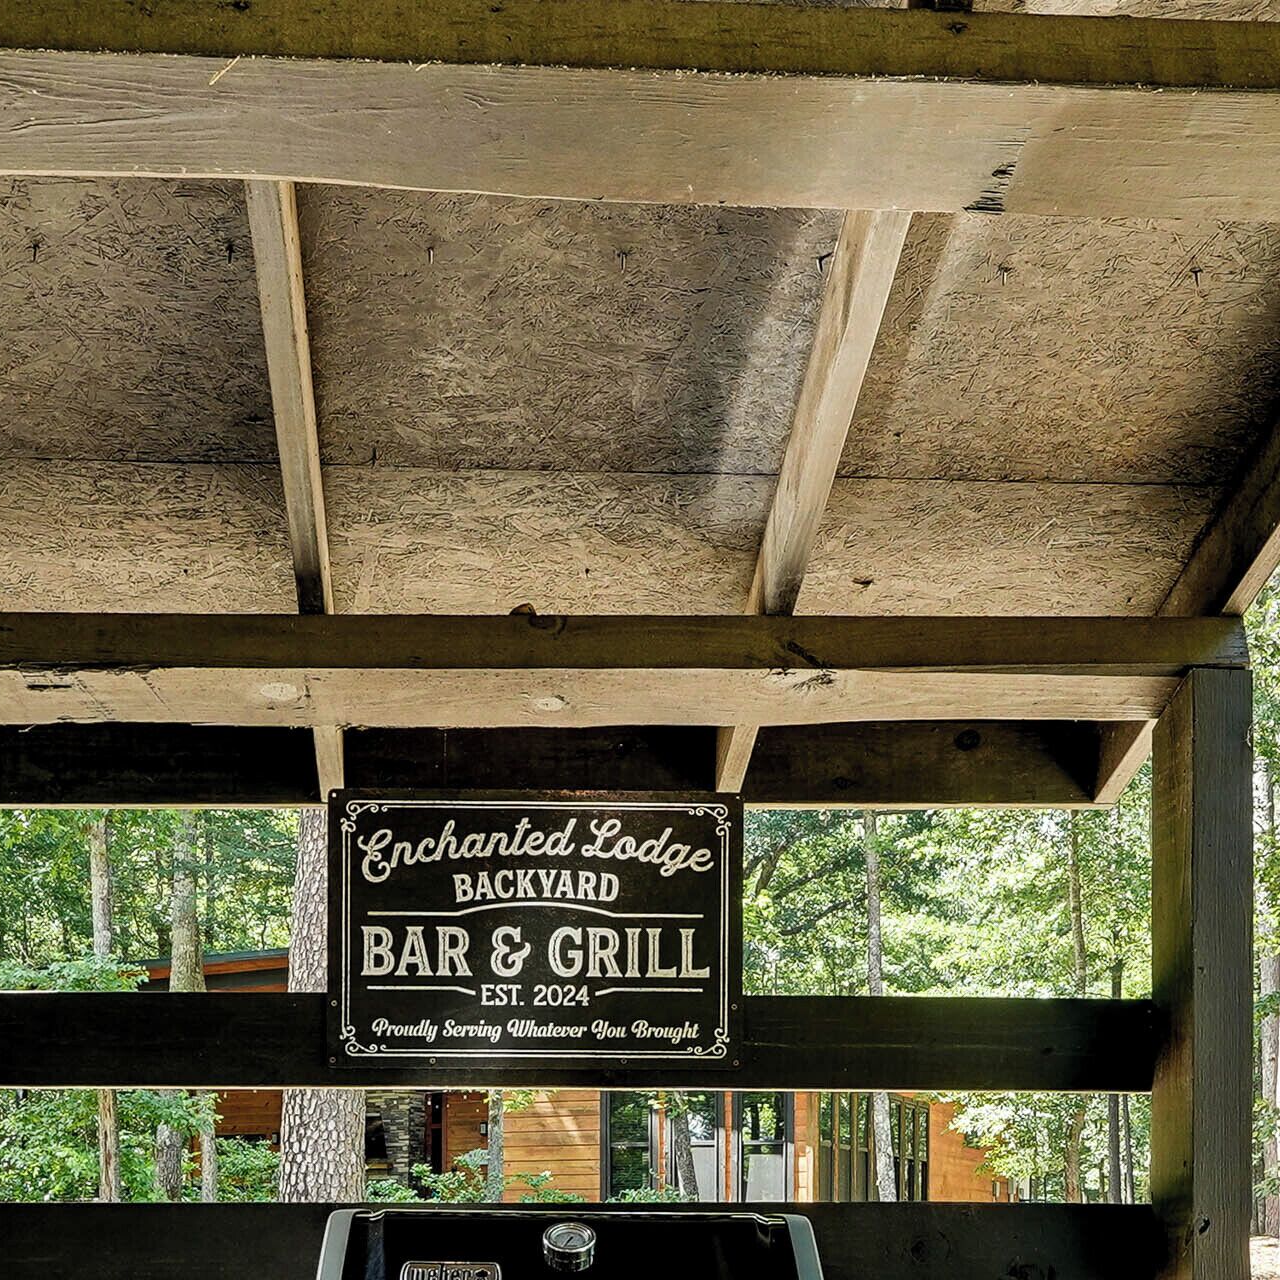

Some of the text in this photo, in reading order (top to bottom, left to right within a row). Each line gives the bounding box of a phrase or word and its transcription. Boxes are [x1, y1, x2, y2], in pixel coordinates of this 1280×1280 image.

[357, 817, 714, 883] Enchanted Lodge
[452, 868, 620, 903] BACKYARD
[360, 925, 710, 979] BAR & GRILL
[480, 984, 590, 1006] EST. 2024
[371, 1017, 700, 1045] Proudly Serving Whatever You Brought
